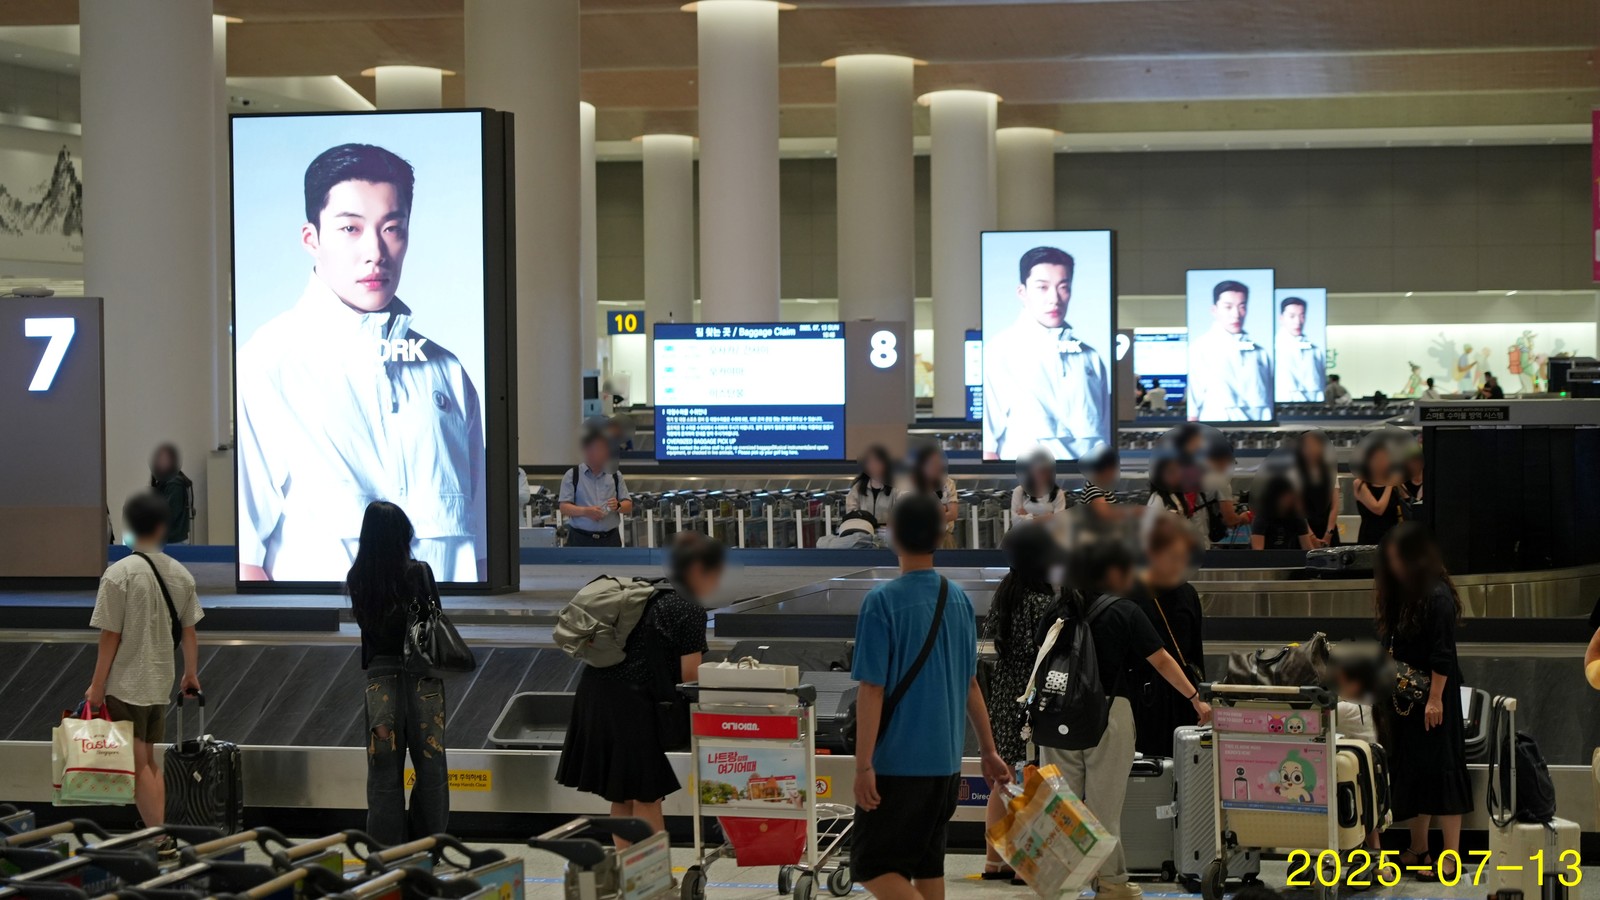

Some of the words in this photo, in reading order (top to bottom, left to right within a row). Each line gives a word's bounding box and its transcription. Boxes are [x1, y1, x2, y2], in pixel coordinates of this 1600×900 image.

[615, 313, 637, 332] 10
[738, 327, 772, 338] Baggage
[774, 326, 796, 337] Claim
[24, 317, 76, 391] 7
[870, 330, 898, 368] 8
[74, 737, 119, 753] Taste
[708, 752, 738, 764] 나트랑
[718, 761, 757, 774] 여기어때
